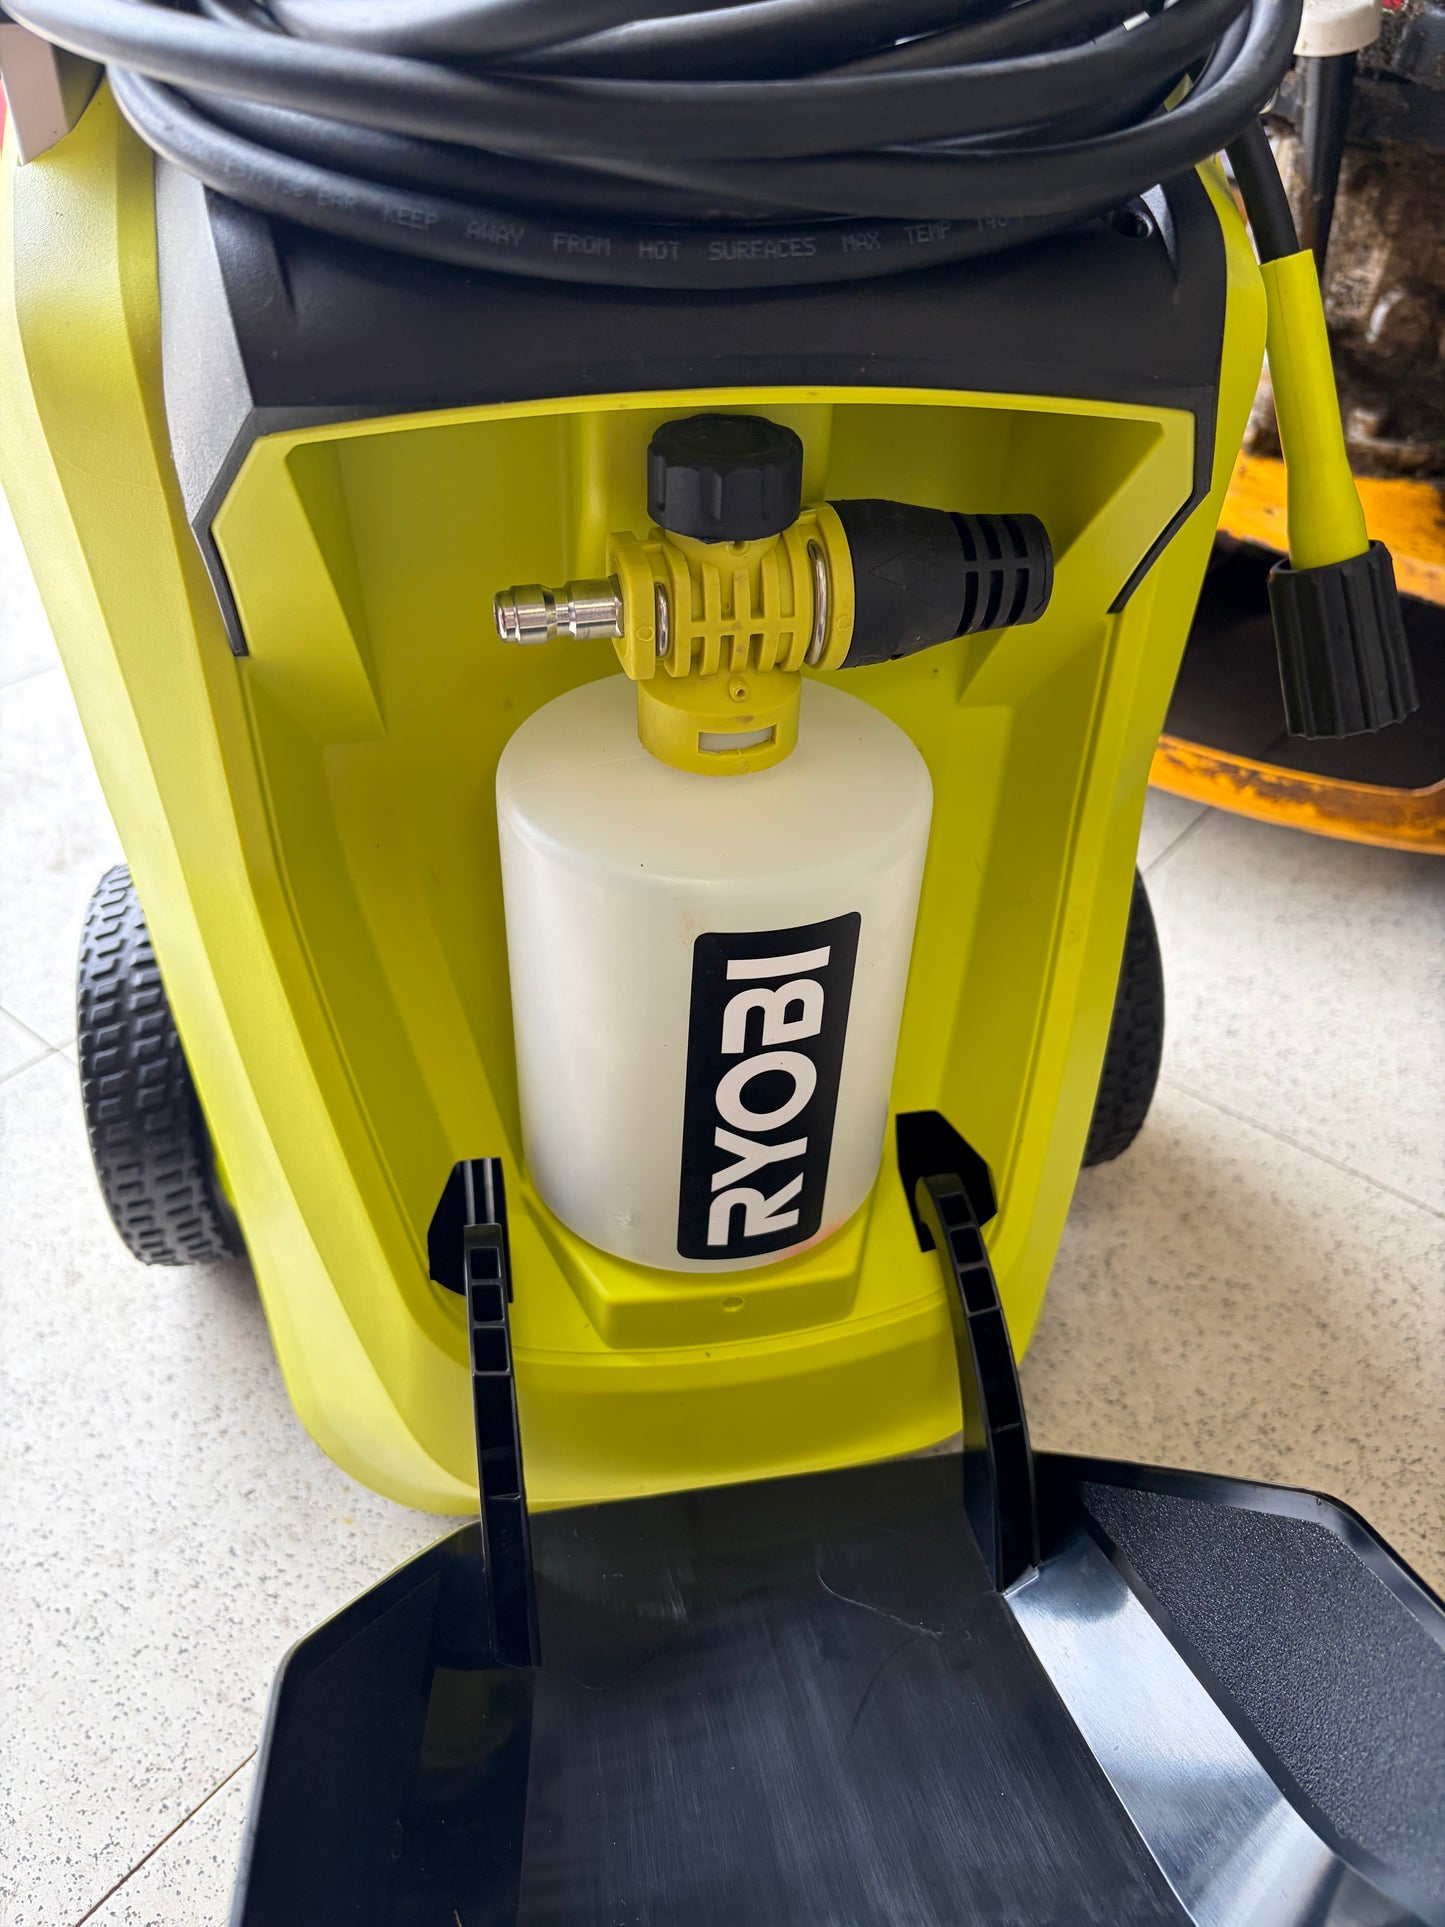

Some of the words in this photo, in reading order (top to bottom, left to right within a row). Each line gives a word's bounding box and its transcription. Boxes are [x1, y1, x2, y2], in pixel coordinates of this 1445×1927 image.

[382, 202, 439, 231] KEEP
[465, 220, 525, 247] AWAY
[552, 231, 611, 256] FROM
[638, 239, 682, 261] HOT
[707, 236, 817, 261] SURFACES
[841, 231, 882, 253] MAX
[903, 220, 953, 246] TEMP
[707, 945, 831, 1247] RYOBI
